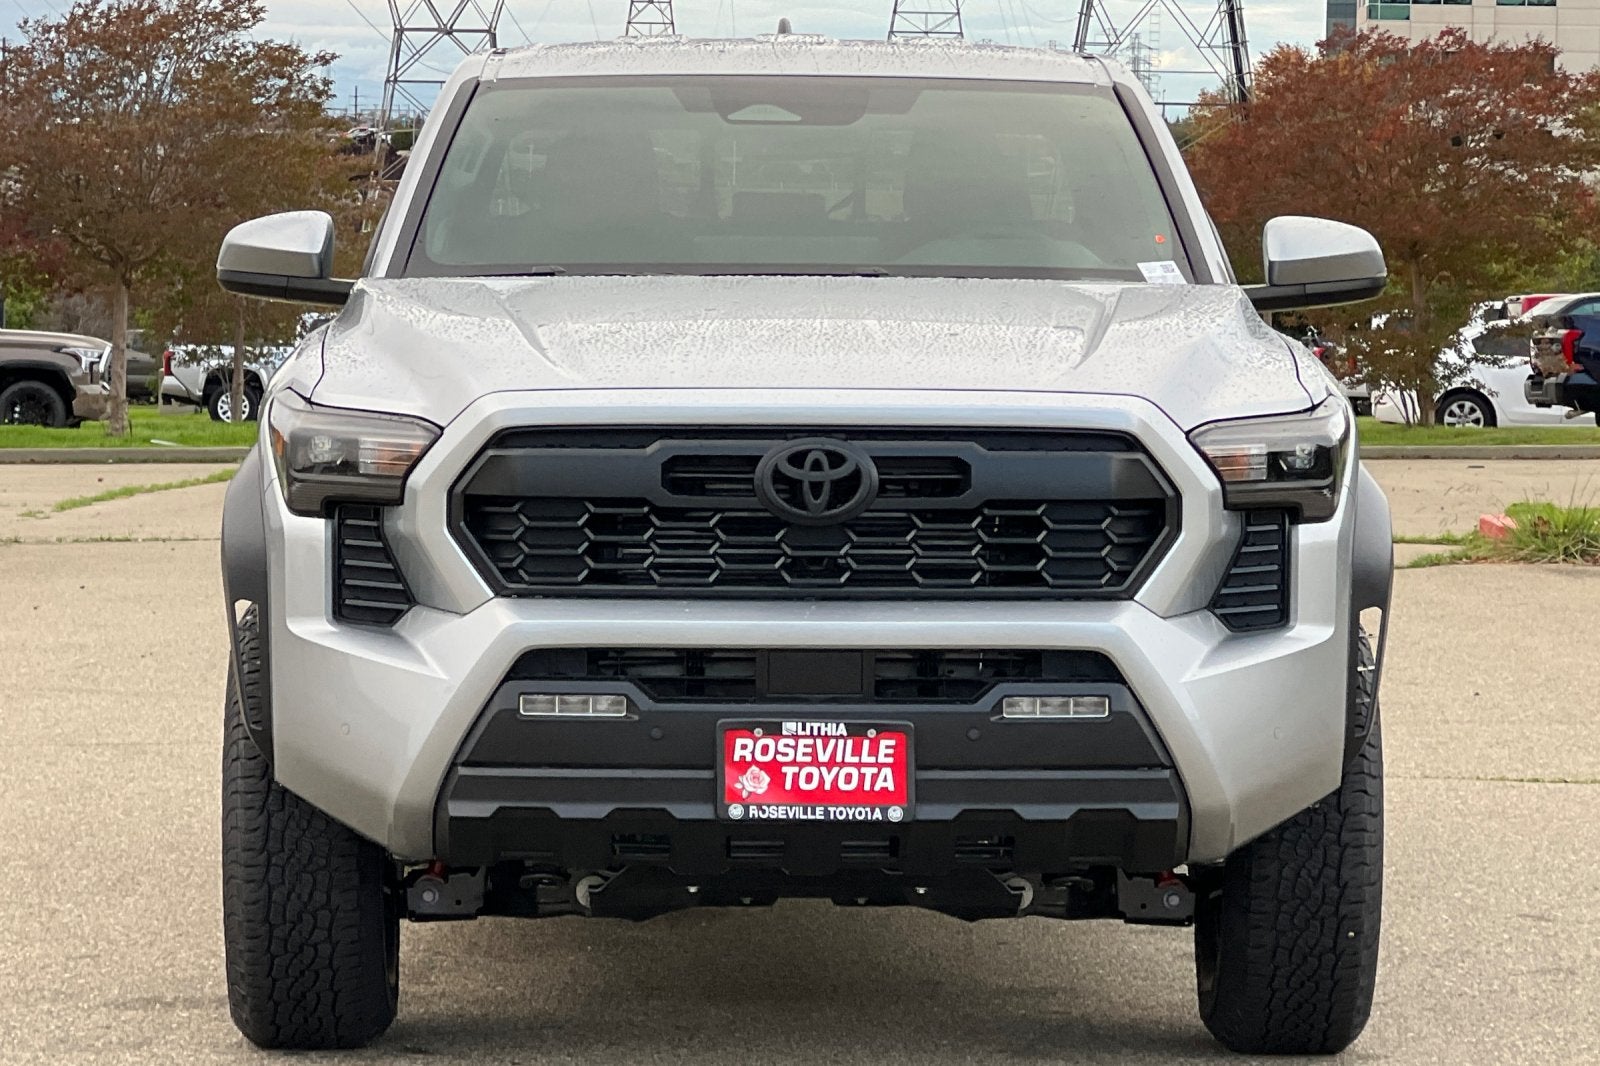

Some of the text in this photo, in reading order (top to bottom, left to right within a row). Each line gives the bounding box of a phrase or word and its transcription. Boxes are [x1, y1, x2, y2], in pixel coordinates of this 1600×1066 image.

[798, 722, 847, 736] LITHIA
[733, 738, 896, 763] ROSEVILLE
[781, 766, 895, 791] TOYOTA
[749, 805, 882, 820] ROSEVILLE TOYOTA
